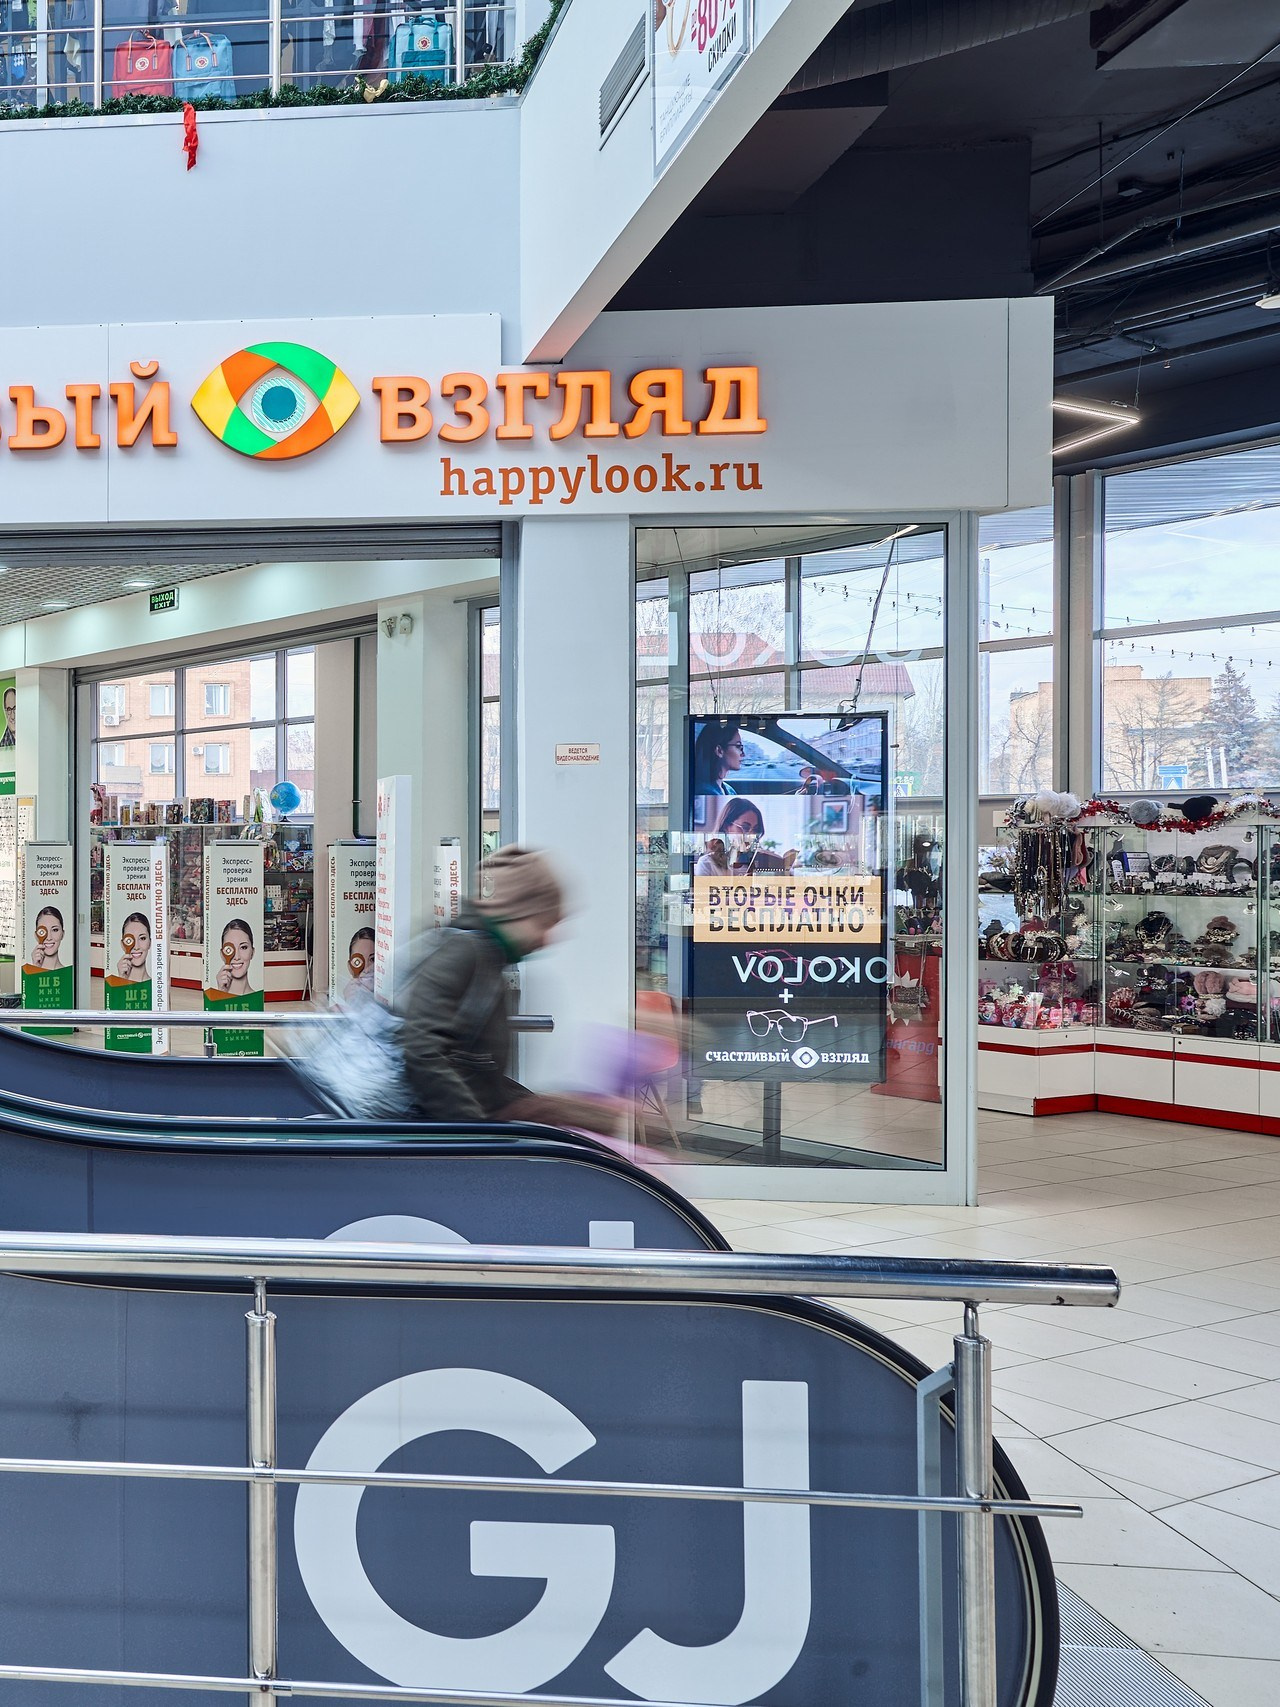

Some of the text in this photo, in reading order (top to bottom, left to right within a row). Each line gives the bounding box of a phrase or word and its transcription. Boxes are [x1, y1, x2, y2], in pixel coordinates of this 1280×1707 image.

[708, 12, 737, 73] СКИДКИ
[372, 366, 768, 444] взгляд
[440, 454, 763, 506] happylook.ru
[151, 591, 174, 603] ВЫХОД
[154, 601, 171, 609] EXIT
[36, 854, 63, 863] Экспресс-
[122, 856, 150, 865] Экспресс-
[222, 857, 253, 866] Экспресс-
[349, 858, 376, 868] Экспрес
[154, 860, 164, 887] ЗДЕСЬ
[350, 870, 376, 878] провер
[450, 860, 459, 888] ЗДЕСЬ
[116, 883, 151, 891] БЕСПЛАТН
[354, 880, 376, 888] зрени
[39, 888, 60, 896] ЗДЕСЬ
[216, 887, 258, 895] БЕСПЛАТНО
[343, 891, 376, 900] БЕСПЛАТ
[126, 892, 147, 901] ЗДЕСЬ
[709, 885, 865, 907] ВТОРЫЕ ОЧКИ
[226, 897, 248, 906] ЗДЕСЬ
[155, 890, 163, 940] БЕСПЛАТНО
[156, 943, 165, 970] зрения
[705, 1048, 870, 1063] счастливый взгляд
[293, 1367, 812, 1706] GJ
